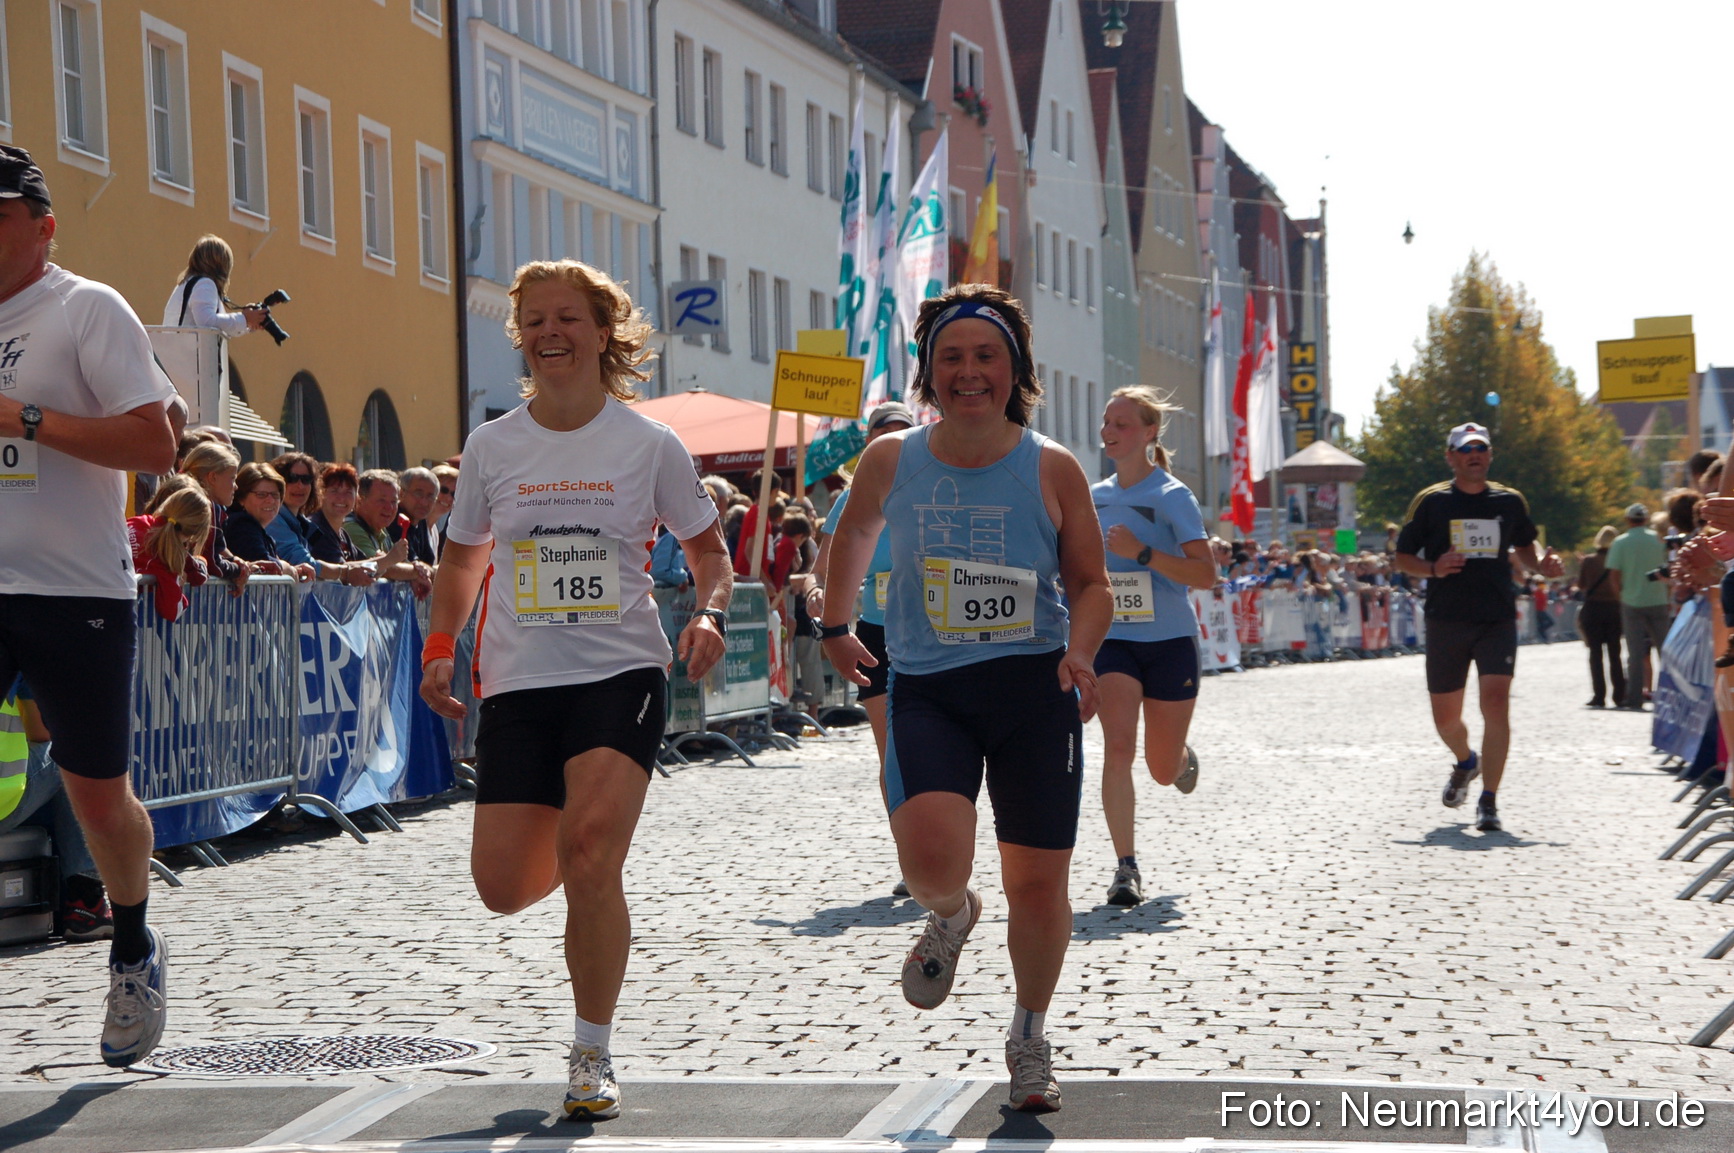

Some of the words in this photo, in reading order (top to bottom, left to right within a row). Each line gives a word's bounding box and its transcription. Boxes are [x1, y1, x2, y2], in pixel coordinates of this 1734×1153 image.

[1603, 354, 1689, 370] Schnupper-
[781, 368, 857, 387] Schnupper-
[1631, 371, 1660, 385] lauf
[804, 387, 830, 401] lauf
[1290, 344, 1318, 450] HOTE
[715, 452, 765, 465] Stadtca
[517, 479, 615, 496] SportScheck
[516, 498, 551, 508] Stadtlauf
[553, 497, 592, 506] München
[594, 498, 615, 507] 2004
[528, 524, 601, 537] Abendzeitung
[1469, 535, 1493, 547] 911
[540, 545, 607, 565] Stephanie
[519, 573, 526, 586] D
[552, 575, 604, 601] 185
[928, 590, 935, 602] D
[1115, 594, 1143, 608] 158
[579, 610, 619, 619] PFLEIDERER
[964, 595, 1016, 621] 930
[991, 625, 1032, 638] PFLEIDERER
